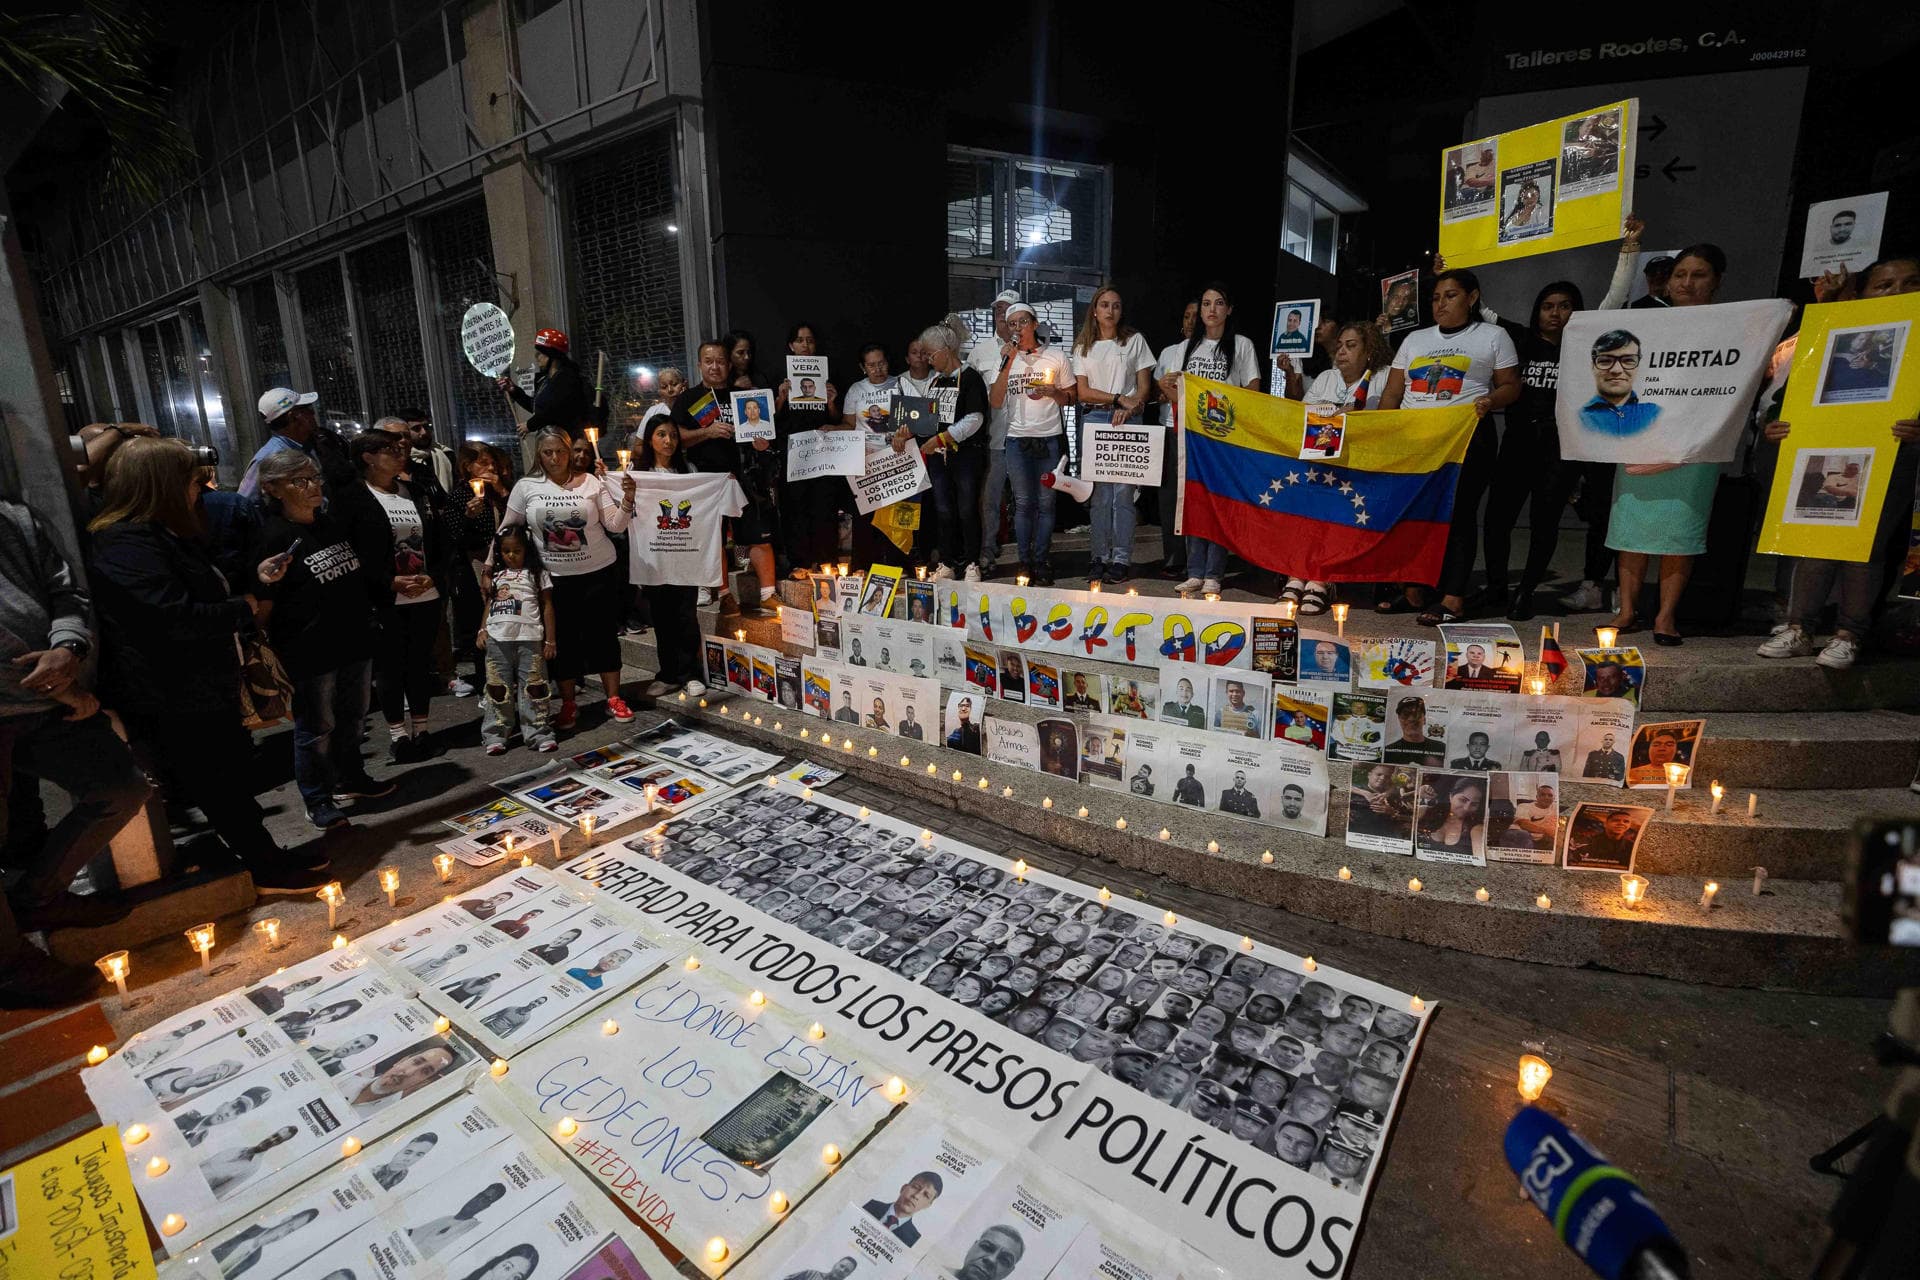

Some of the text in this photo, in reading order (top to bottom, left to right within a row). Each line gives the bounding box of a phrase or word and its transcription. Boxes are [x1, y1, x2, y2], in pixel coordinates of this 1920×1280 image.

[1505, 29, 1747, 70] Talleres Rootes, C.A.
[1649, 348, 1741, 369] LIBERTAD
[1642, 385, 1737, 397] JONATHAN CARRILLO
[739, 430, 773, 439] LIBERTAD
[1095, 431, 1149, 442] MENOS DE 1%
[1095, 443, 1151, 454] DE PRESOS
[882, 460, 895, 471] PAZ
[896, 458, 904, 466] ES
[905, 454, 913, 463] LA
[857, 473, 888, 488] LIBERTAD
[864, 473, 915, 497] LOS PRESOS
[1106, 470, 1145, 479] VENEZUELA
[303, 543, 341, 567] CIERREN
[309, 549, 354, 574] CENTROS
[840, 582, 859, 591] VERA
[950, 588, 1247, 667] LIBERTAD
[1610, 722, 1630, 730] PLAZA
[999, 735, 1030, 754] Armas
[519, 820, 550, 836] TODOS
[565, 851, 1354, 1280] LIBERTAD PARA TODOS LOS PRESOS POLÍTICOS
[642, 1046, 716, 1098] LOS
[763, 1035, 883, 1109] ESTÁN
[535, 1055, 773, 1214] GEDEONES?
[935, 1154, 966, 1176] GUEVARA
[942, 1152, 968, 1170] CARLOS
[511, 1163, 532, 1184] ARGENIS
[573, 1136, 675, 1233] #FEDEVIDA
[1012, 1202, 1046, 1230] GUEVARA
[1017, 1198, 1047, 1223] OTONIEL
[1040, 1202, 1064, 1220] LIBERTAD
[554, 1218, 576, 1243] OROZCO
[559, 1211, 584, 1241] ANDREINA
[855, 1238, 880, 1260] OCHOA
[866, 1238, 895, 1264] GABRIEL
[880, 1233, 903, 1254] LIBERTAD
[382, 1246, 399, 1270] DANIEL
